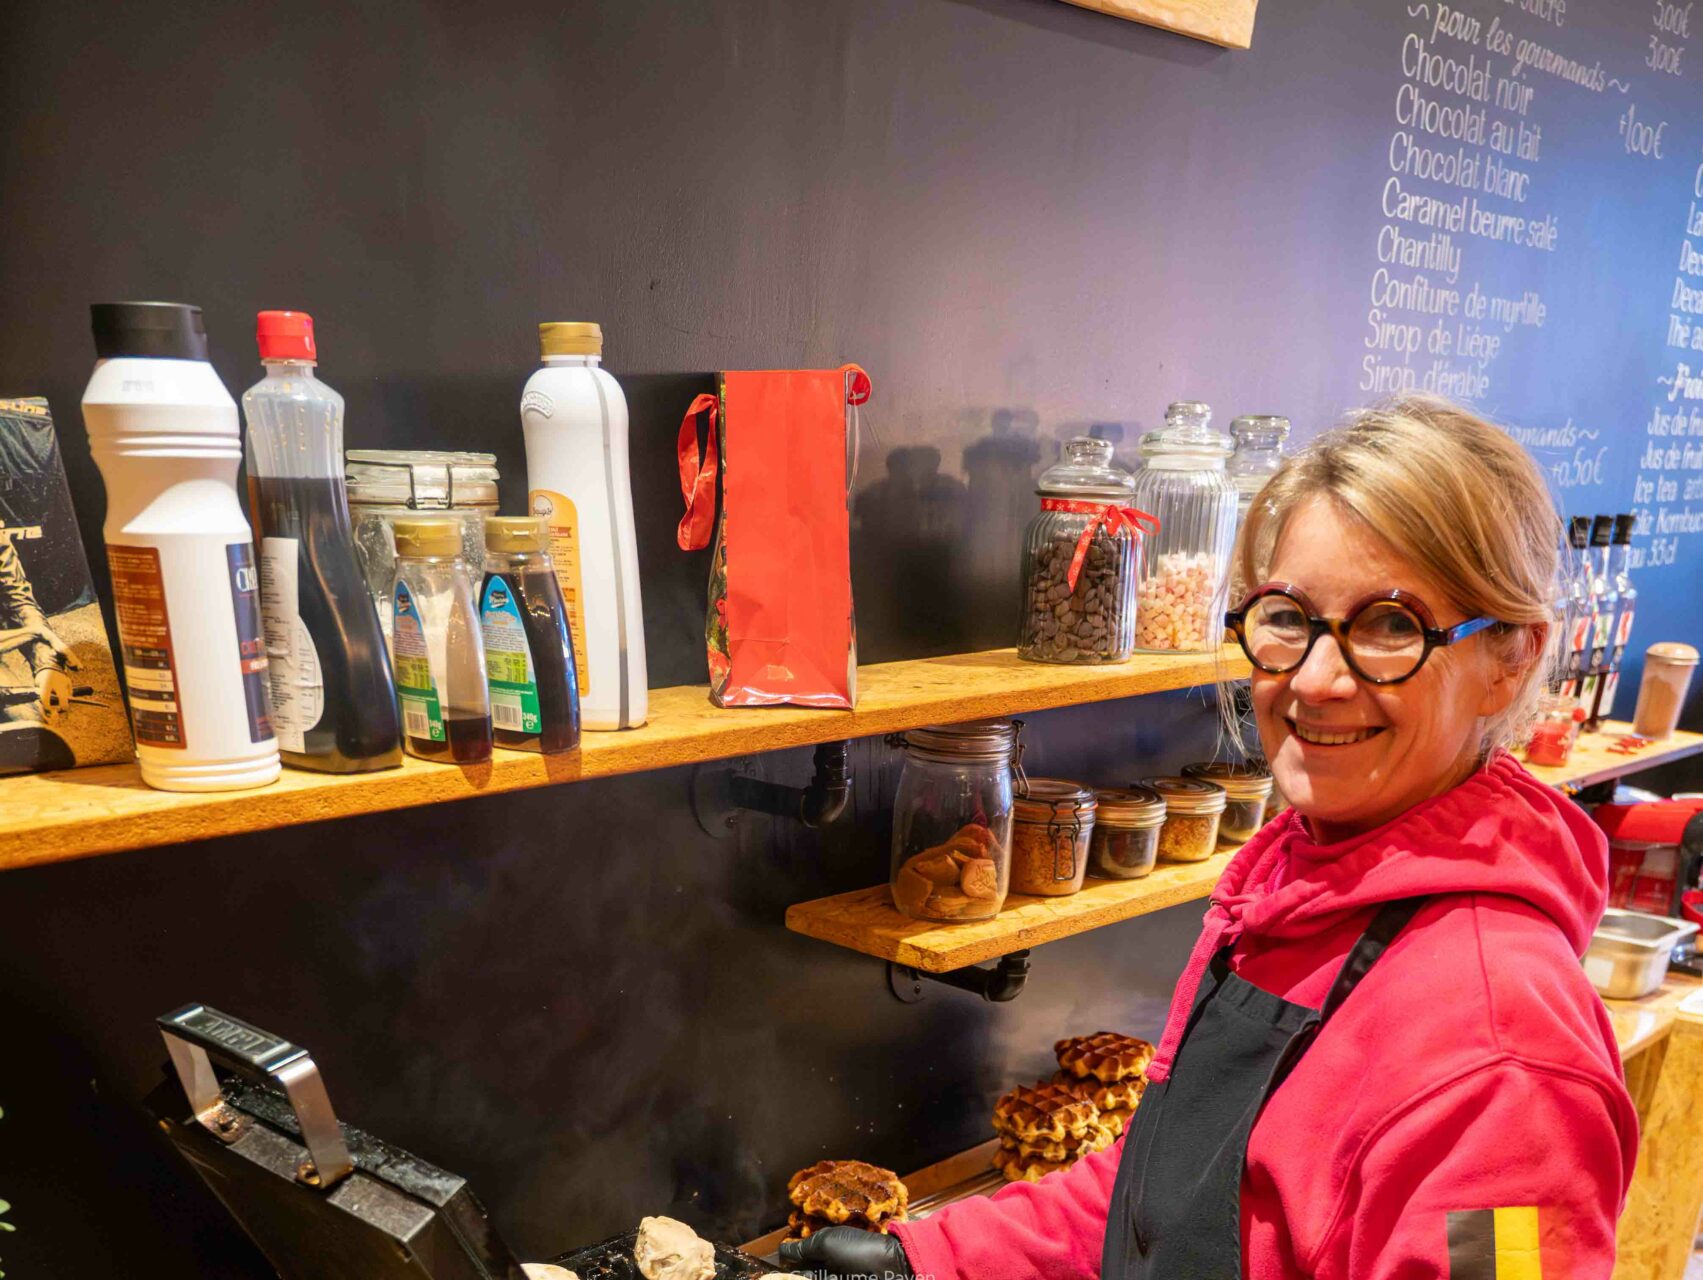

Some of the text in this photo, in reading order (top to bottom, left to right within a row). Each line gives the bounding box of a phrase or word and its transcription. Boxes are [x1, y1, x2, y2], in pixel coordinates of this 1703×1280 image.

[1401, 33, 1535, 116] Chocolat noir
[1430, 2, 1606, 92] pour les gourmands
[1395, 83, 1542, 162] Chocolat au lait
[1388, 131, 1531, 203] Chocolat blanc
[1381, 176, 1559, 252] Caramel beurre salé
[1376, 224, 1462, 284] Chantilly
[1370, 267, 1461, 316] Confiture
[1464, 281, 1487, 320] de
[1363, 308, 1422, 365] Sirop
[1427, 319, 1452, 357] de
[1359, 354, 1416, 396] Sirop
